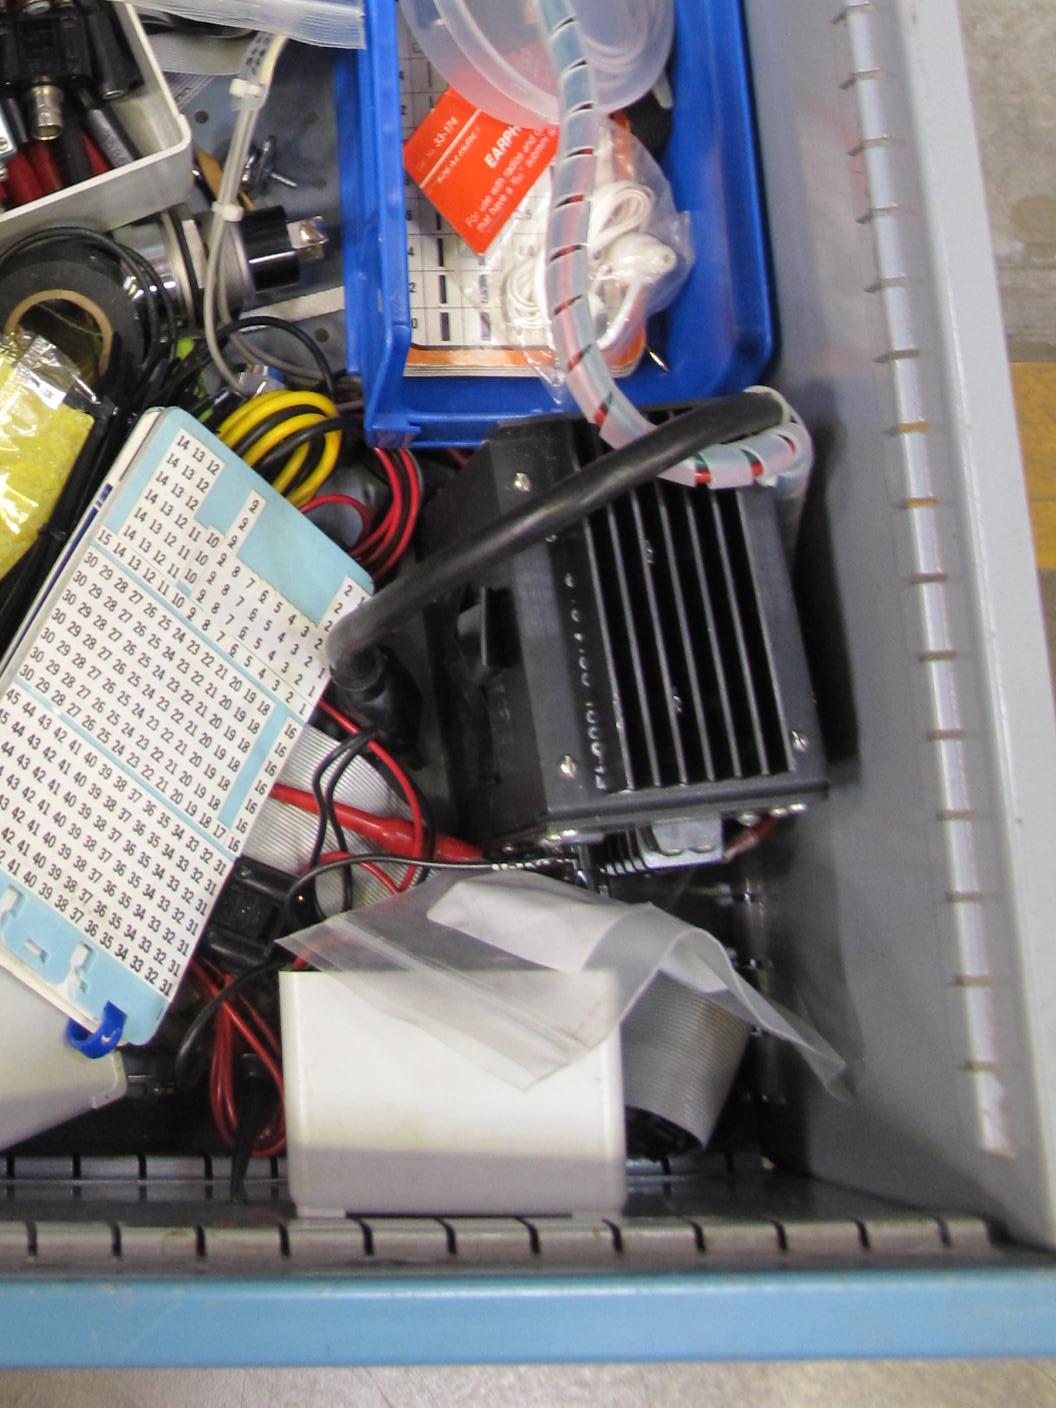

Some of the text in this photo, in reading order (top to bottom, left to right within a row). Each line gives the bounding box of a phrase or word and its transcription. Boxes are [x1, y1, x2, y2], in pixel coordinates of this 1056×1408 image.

[484, 125, 523, 169] EARPH
[96, 528, 112, 546] 15
[112, 541, 127, 558] 14
[126, 554, 142, 571] 13
[141, 566, 156, 584] 12
[156, 579, 170, 596] 11
[170, 591, 185, 609] 10
[133, 506, 148, 523] 14
[148, 518, 163, 535] 13
[162, 530, 177, 548] 12
[176, 544, 190, 561] 11
[194, 549, 209, 566] 10
[50, 607, 268, 796] 30 29 28 27 26 25 24 23 22 21 20 19 18 16
[83, 550, 297, 739] 30 29 28 27 26 25 24 23 22 21 20 19 18 16
[5, 687, 227, 877] 45 44 43 42 41 40 39 38 37 36 35 34 33 32 31
[18, 663, 241, 853] 30 29 28 27 26 25 24 23 22 21 20 19 18 17 16
[5, 772, 20, 791] 43
[21, 785, 36, 804] 42
[36, 798, 51, 816] 41
[51, 810, 67, 828] 40
[66, 822, 82, 840] 39
[82, 834, 97, 852] 38
[97, 846, 113, 863] 37
[111, 858, 127, 877] 36
[126, 870, 142, 889] 35
[141, 882, 156, 900] 34
[156, 894, 171, 913] 33
[170, 906, 185, 925] 32
[184, 917, 199, 936] 31
[6, 857, 21, 876] 41
[22, 870, 38, 888] 40
[37, 881, 53, 900] 39
[53, 893, 69, 912] 38
[68, 906, 85, 924] 37
[83, 918, 99, 937] 36
[98, 930, 114, 950] 35
[113, 942, 129, 962] 34
[128, 954, 144, 973] 33
[143, 965, 159, 985] 32
[157, 977, 173, 997] 31
